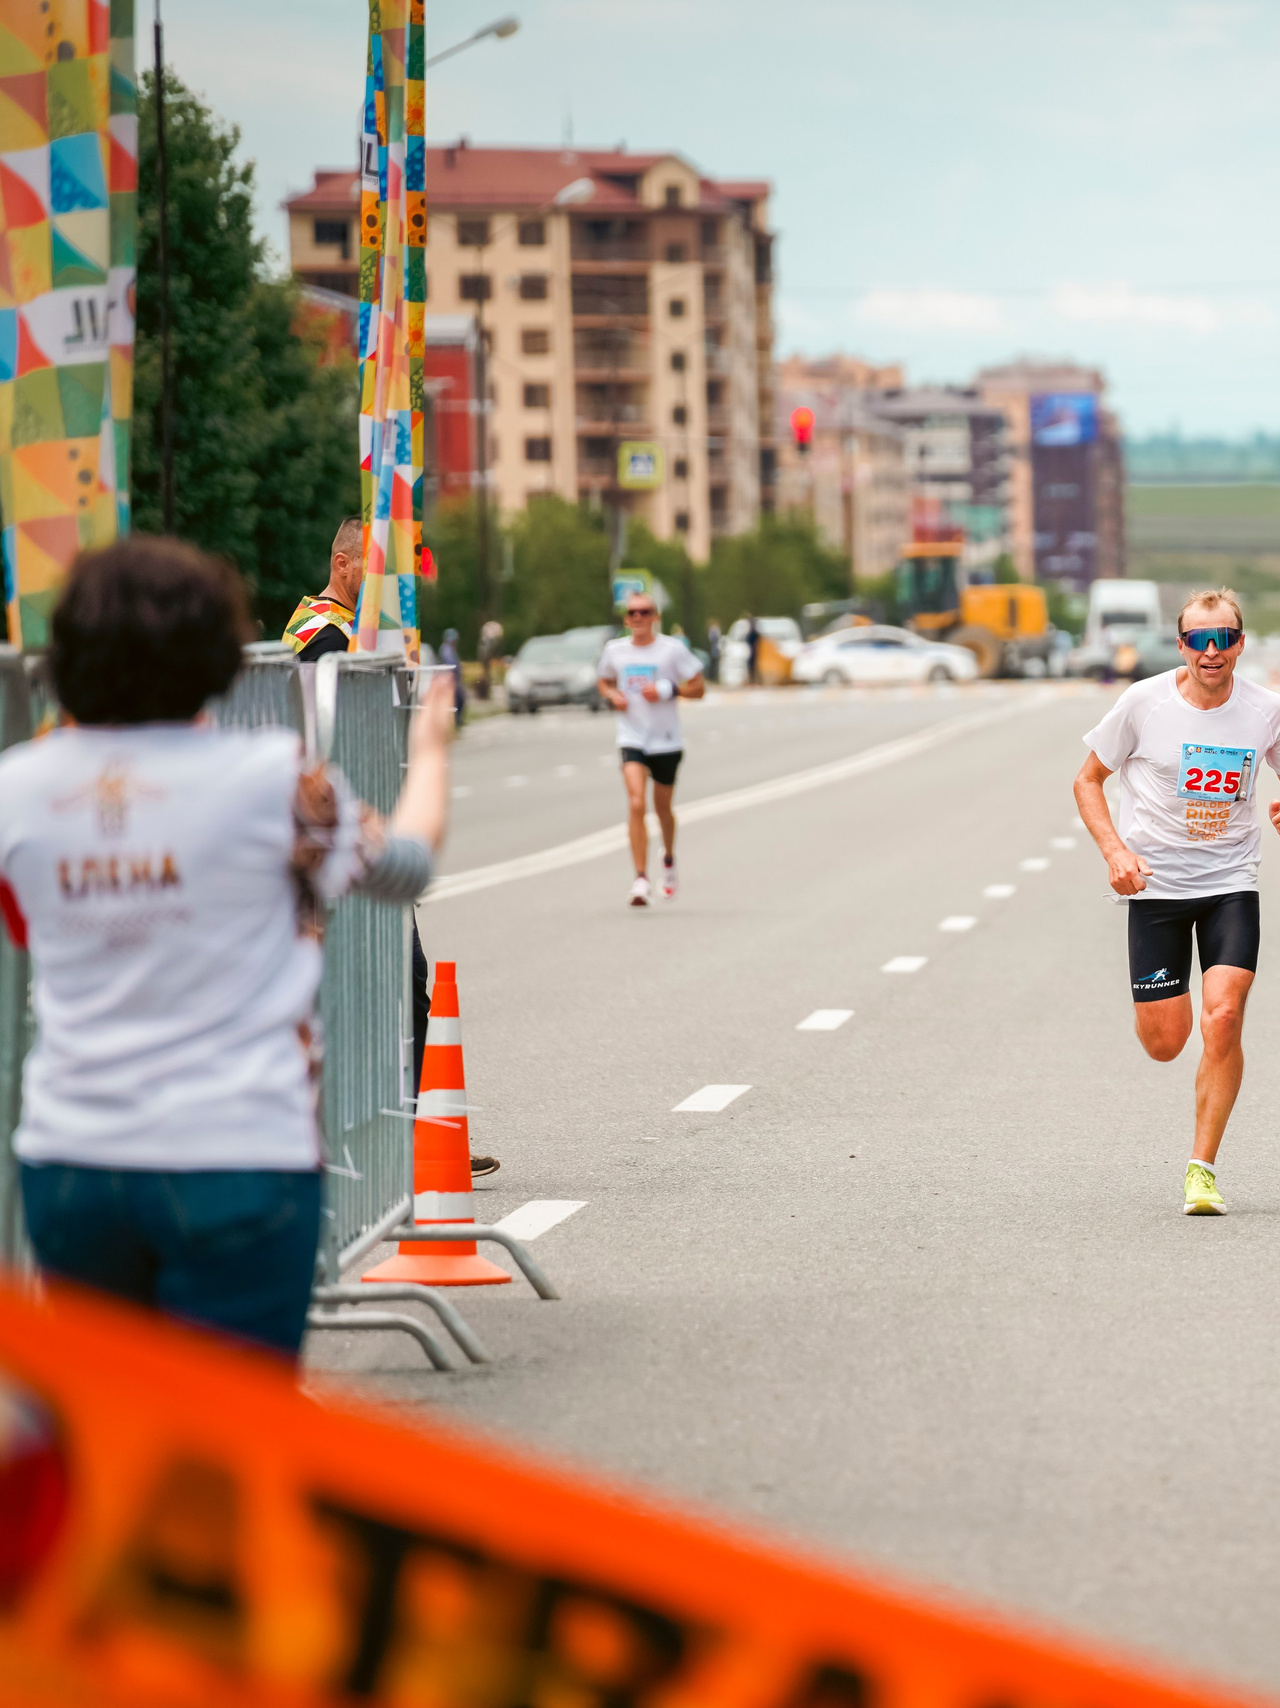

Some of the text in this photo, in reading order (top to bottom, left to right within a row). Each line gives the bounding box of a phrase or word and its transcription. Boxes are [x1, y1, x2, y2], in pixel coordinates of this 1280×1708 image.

[1184, 767, 1241, 795] 225
[1187, 800, 1231, 808] GOLDEN
[1186, 808, 1230, 819] RING
[1186, 820, 1228, 829] ULTRA
[1133, 979, 1180, 989] SKYRUNNER
